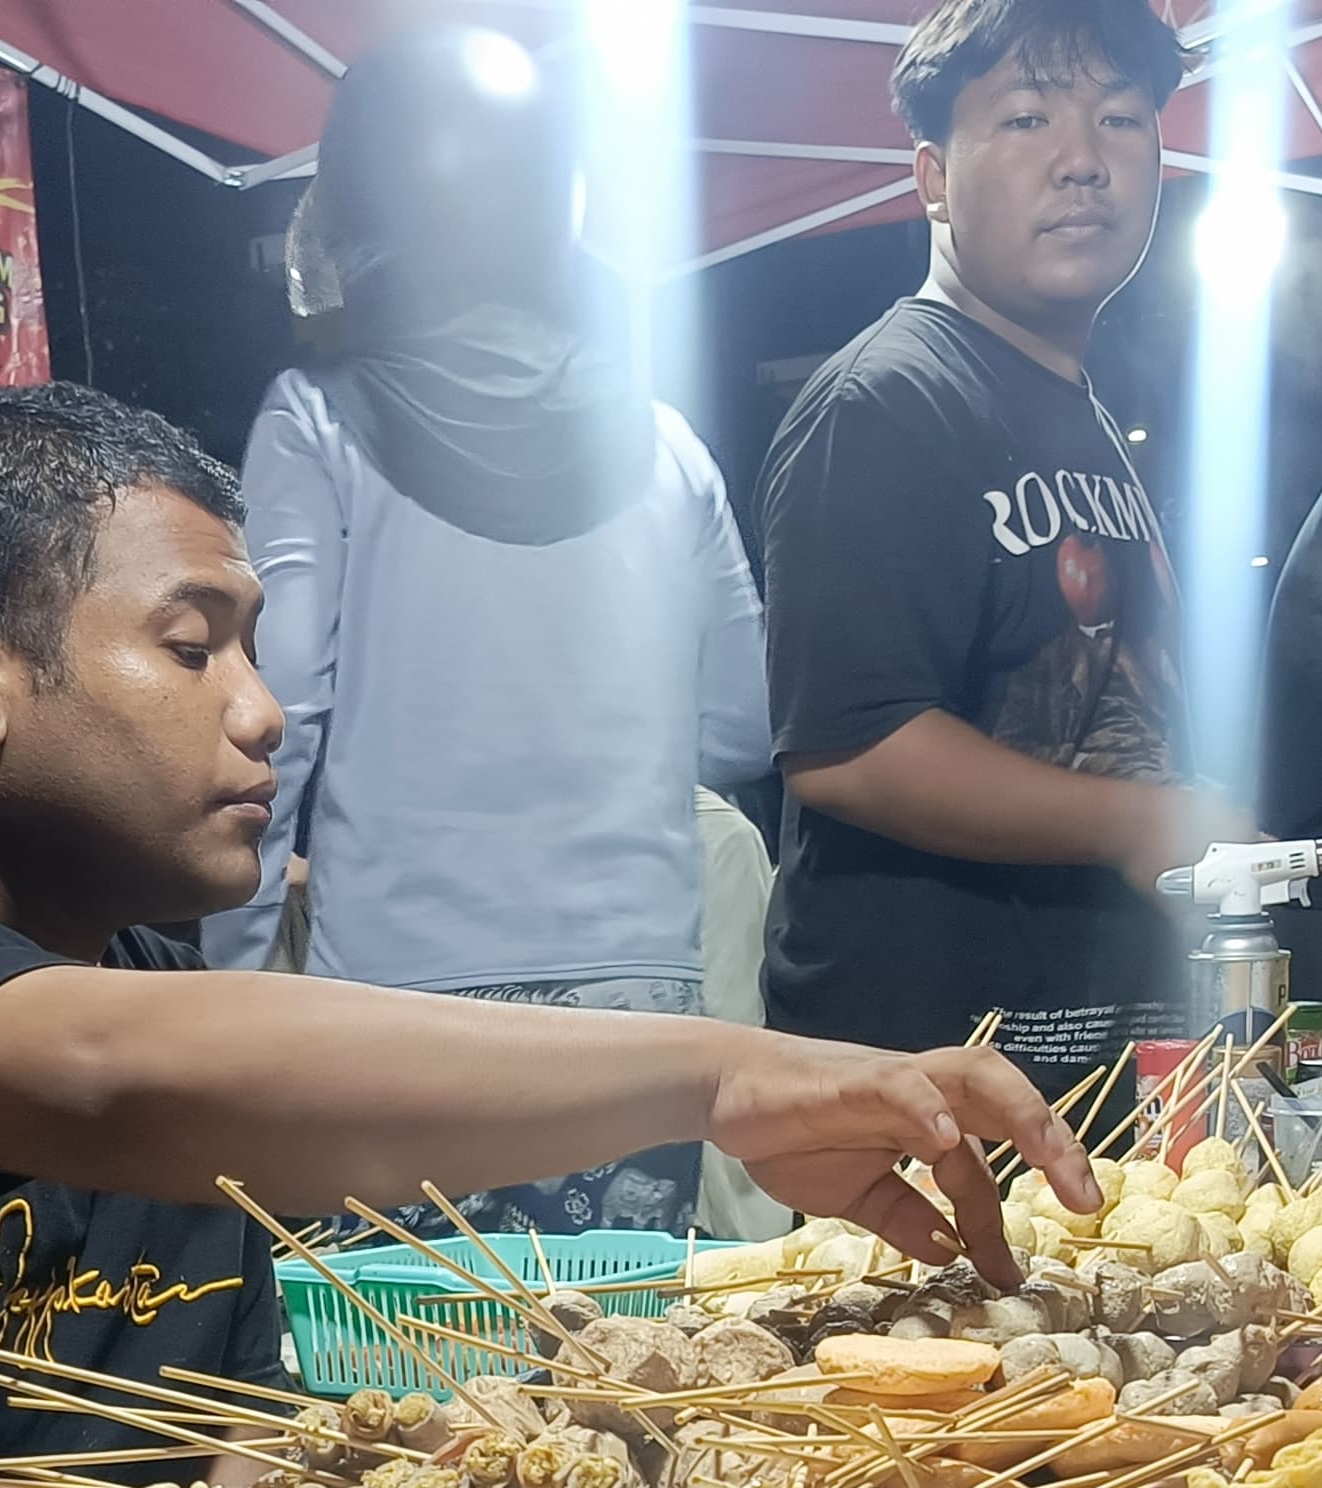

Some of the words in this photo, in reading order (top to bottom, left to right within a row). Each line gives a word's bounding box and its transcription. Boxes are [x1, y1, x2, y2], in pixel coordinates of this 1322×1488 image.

[983, 468, 1155, 556] ROCKM
[1049, 1009, 1062, 1020] of
[1032, 1022, 1054, 1033] and
[1045, 1032, 1072, 1043] with
[1033, 1054, 1058, 1064] and
